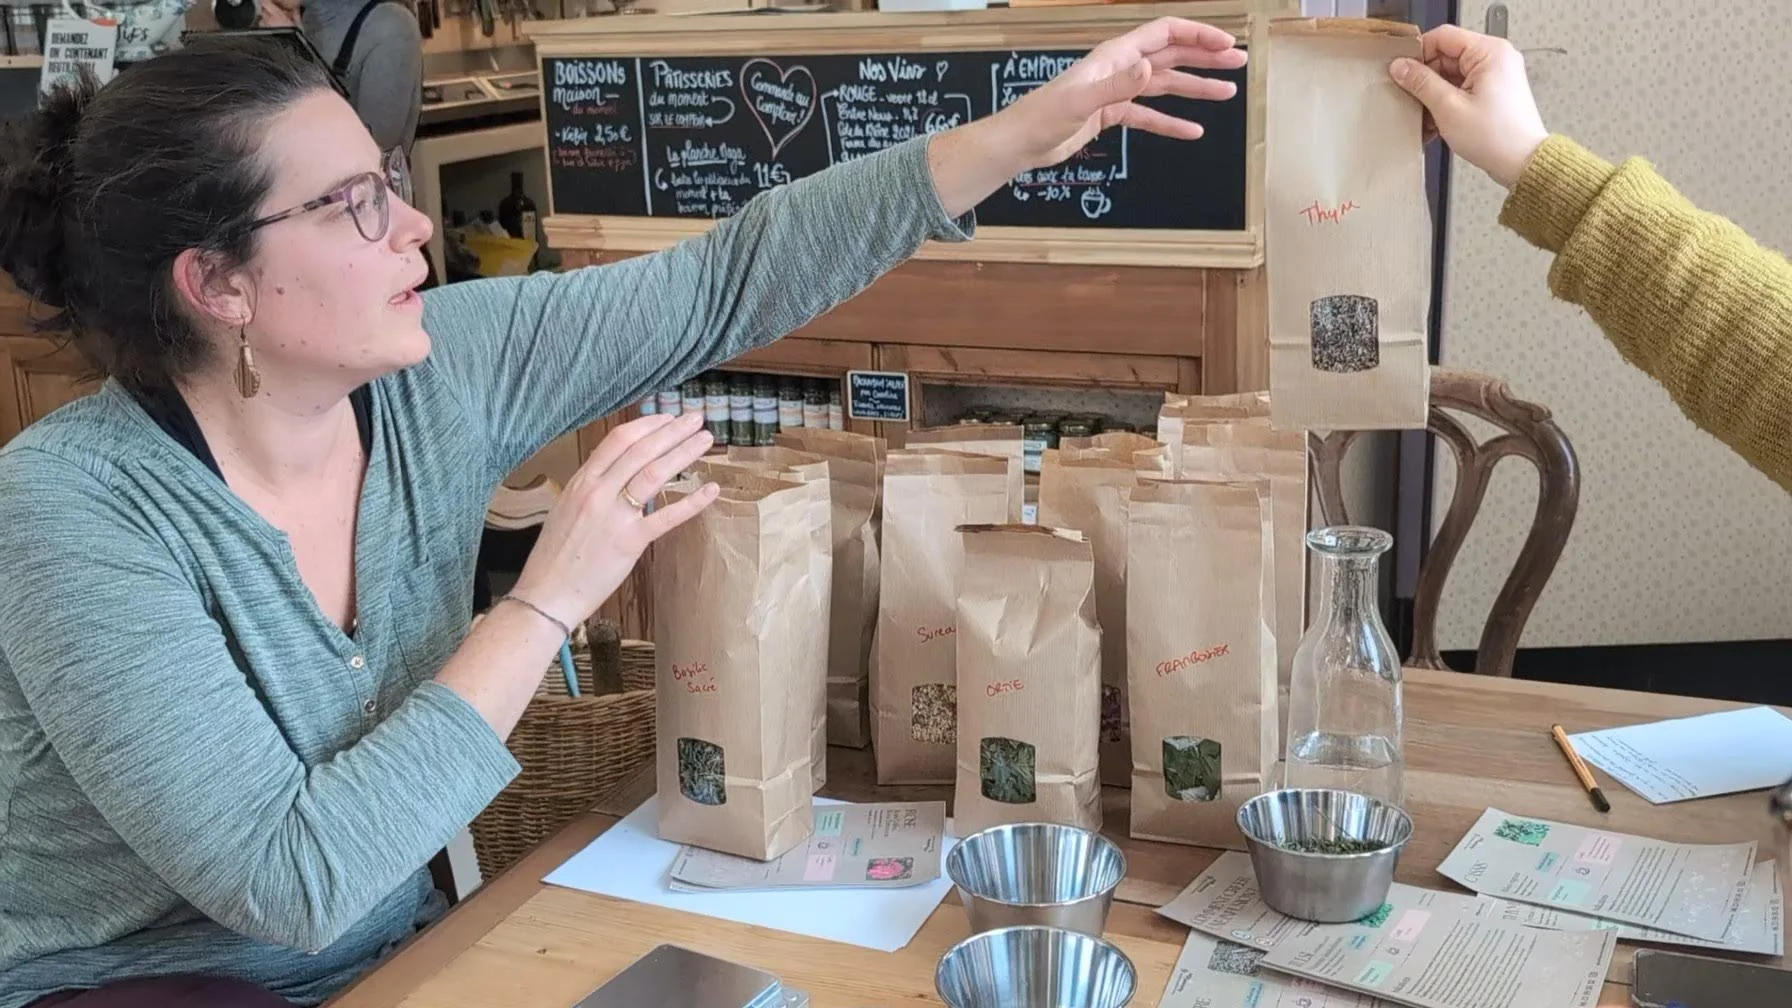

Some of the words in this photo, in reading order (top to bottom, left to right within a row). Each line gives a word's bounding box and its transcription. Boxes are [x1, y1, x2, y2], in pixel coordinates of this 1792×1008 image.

[51, 32, 88, 45] DEMANDEZ
[64, 47, 108, 59] CONTENANT
[859, 57, 887, 82] Nos
[887, 56, 926, 82] Vins
[1003, 52, 1018, 79] À
[648, 91, 665, 106] du
[667, 91, 709, 107] moment
[840, 84, 877, 102] ROUGE
[916, 625, 957, 644] Surea
[687, 676, 718, 693] Sacré
